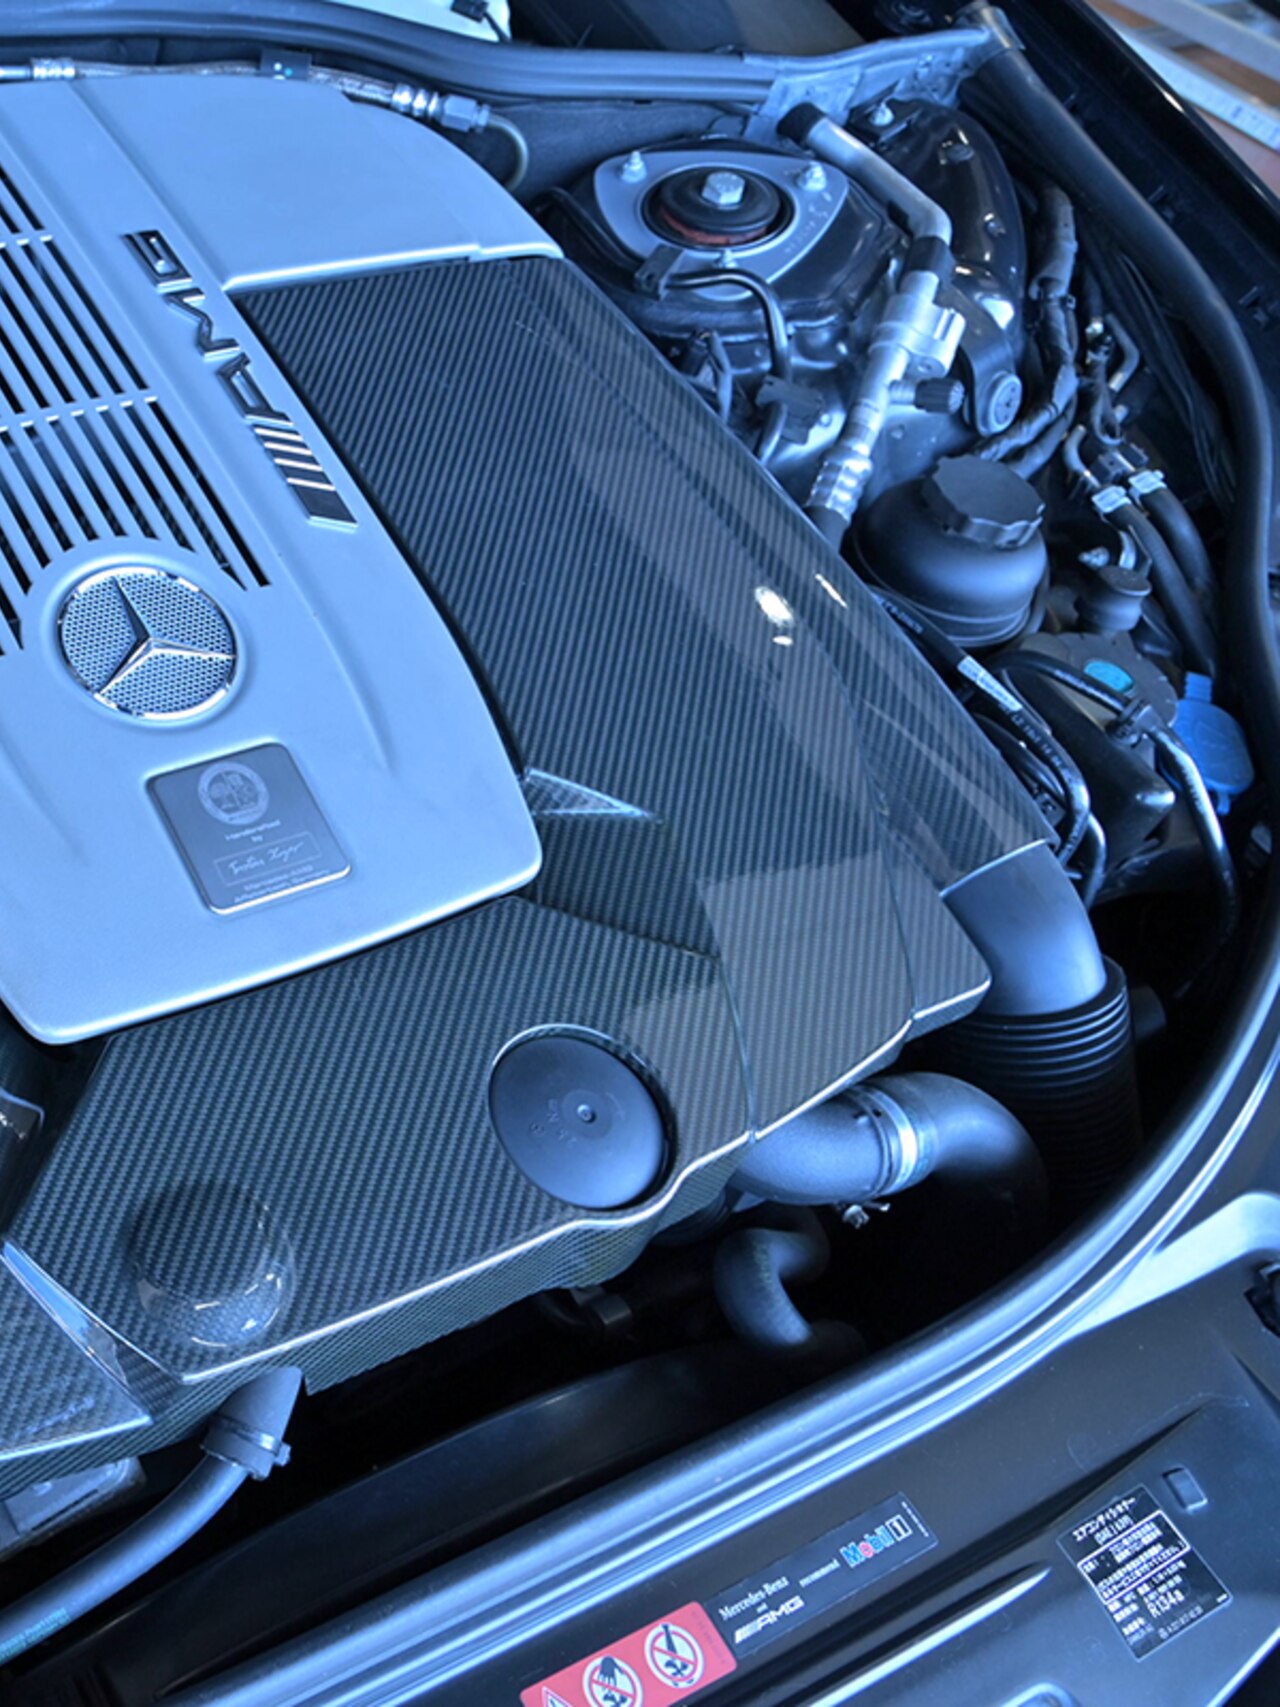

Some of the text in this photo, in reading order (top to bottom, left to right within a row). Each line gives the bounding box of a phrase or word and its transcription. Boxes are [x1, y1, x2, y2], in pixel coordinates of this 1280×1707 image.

[121, 229, 294, 426] AMG
[719, 1576, 790, 1621] Mercedes-Benz
[839, 1525, 896, 1568] Mobil
[1146, 1589, 1185, 1618] R134a
